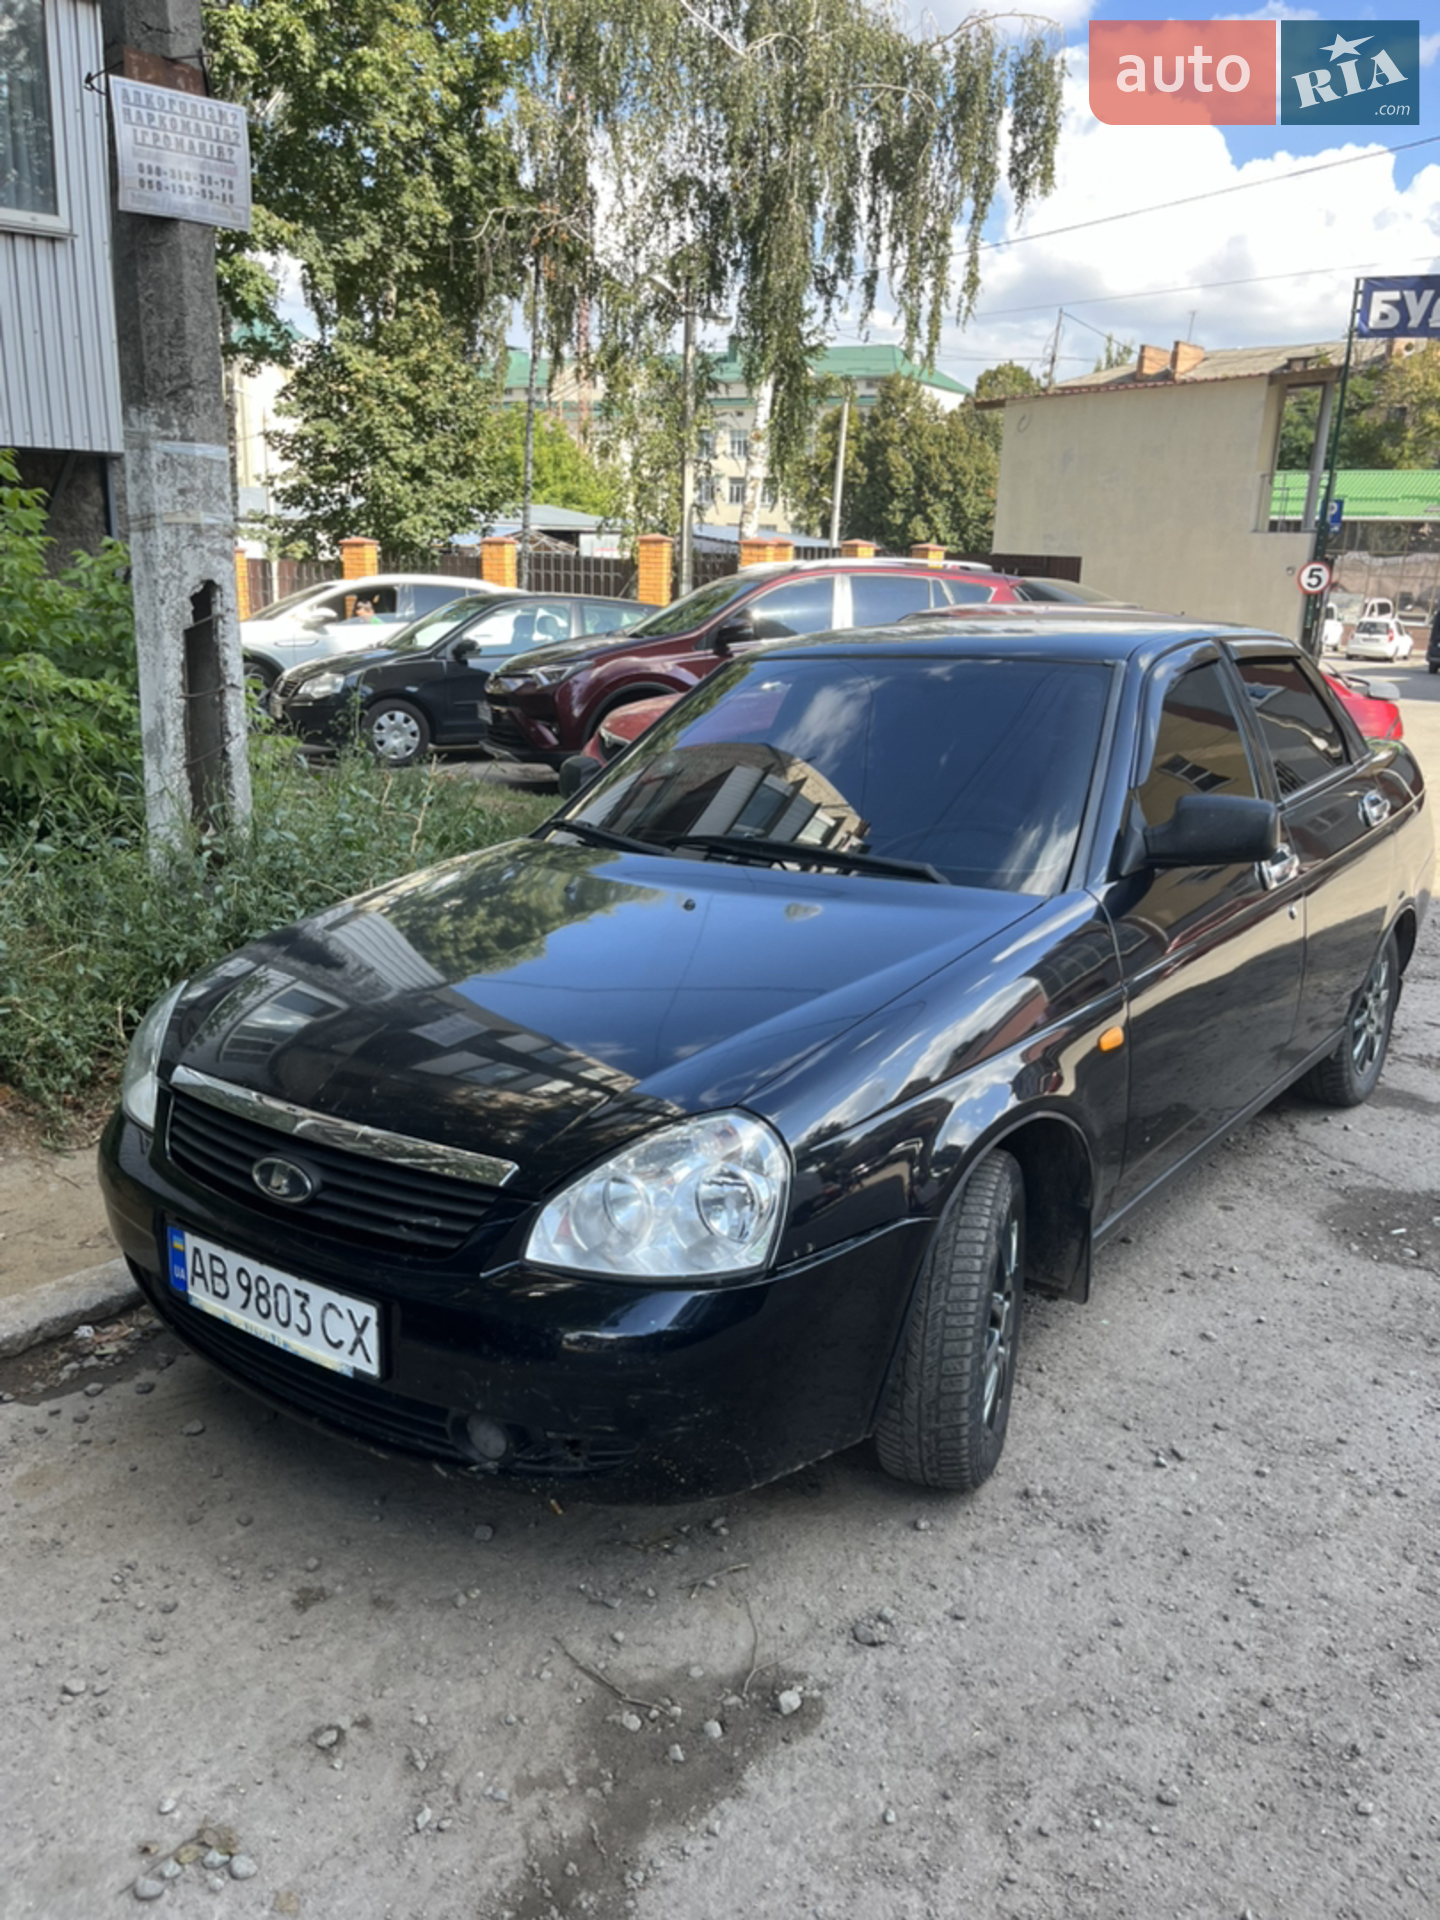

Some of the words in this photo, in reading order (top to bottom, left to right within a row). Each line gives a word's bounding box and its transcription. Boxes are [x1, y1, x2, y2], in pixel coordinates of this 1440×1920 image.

[1307, 568, 1323, 588] 5
[174, 1264, 186, 1280] UA
[190, 1246, 230, 1301] AB
[236, 1267, 312, 1337] 9803
[321, 1302, 372, 1365] CX
